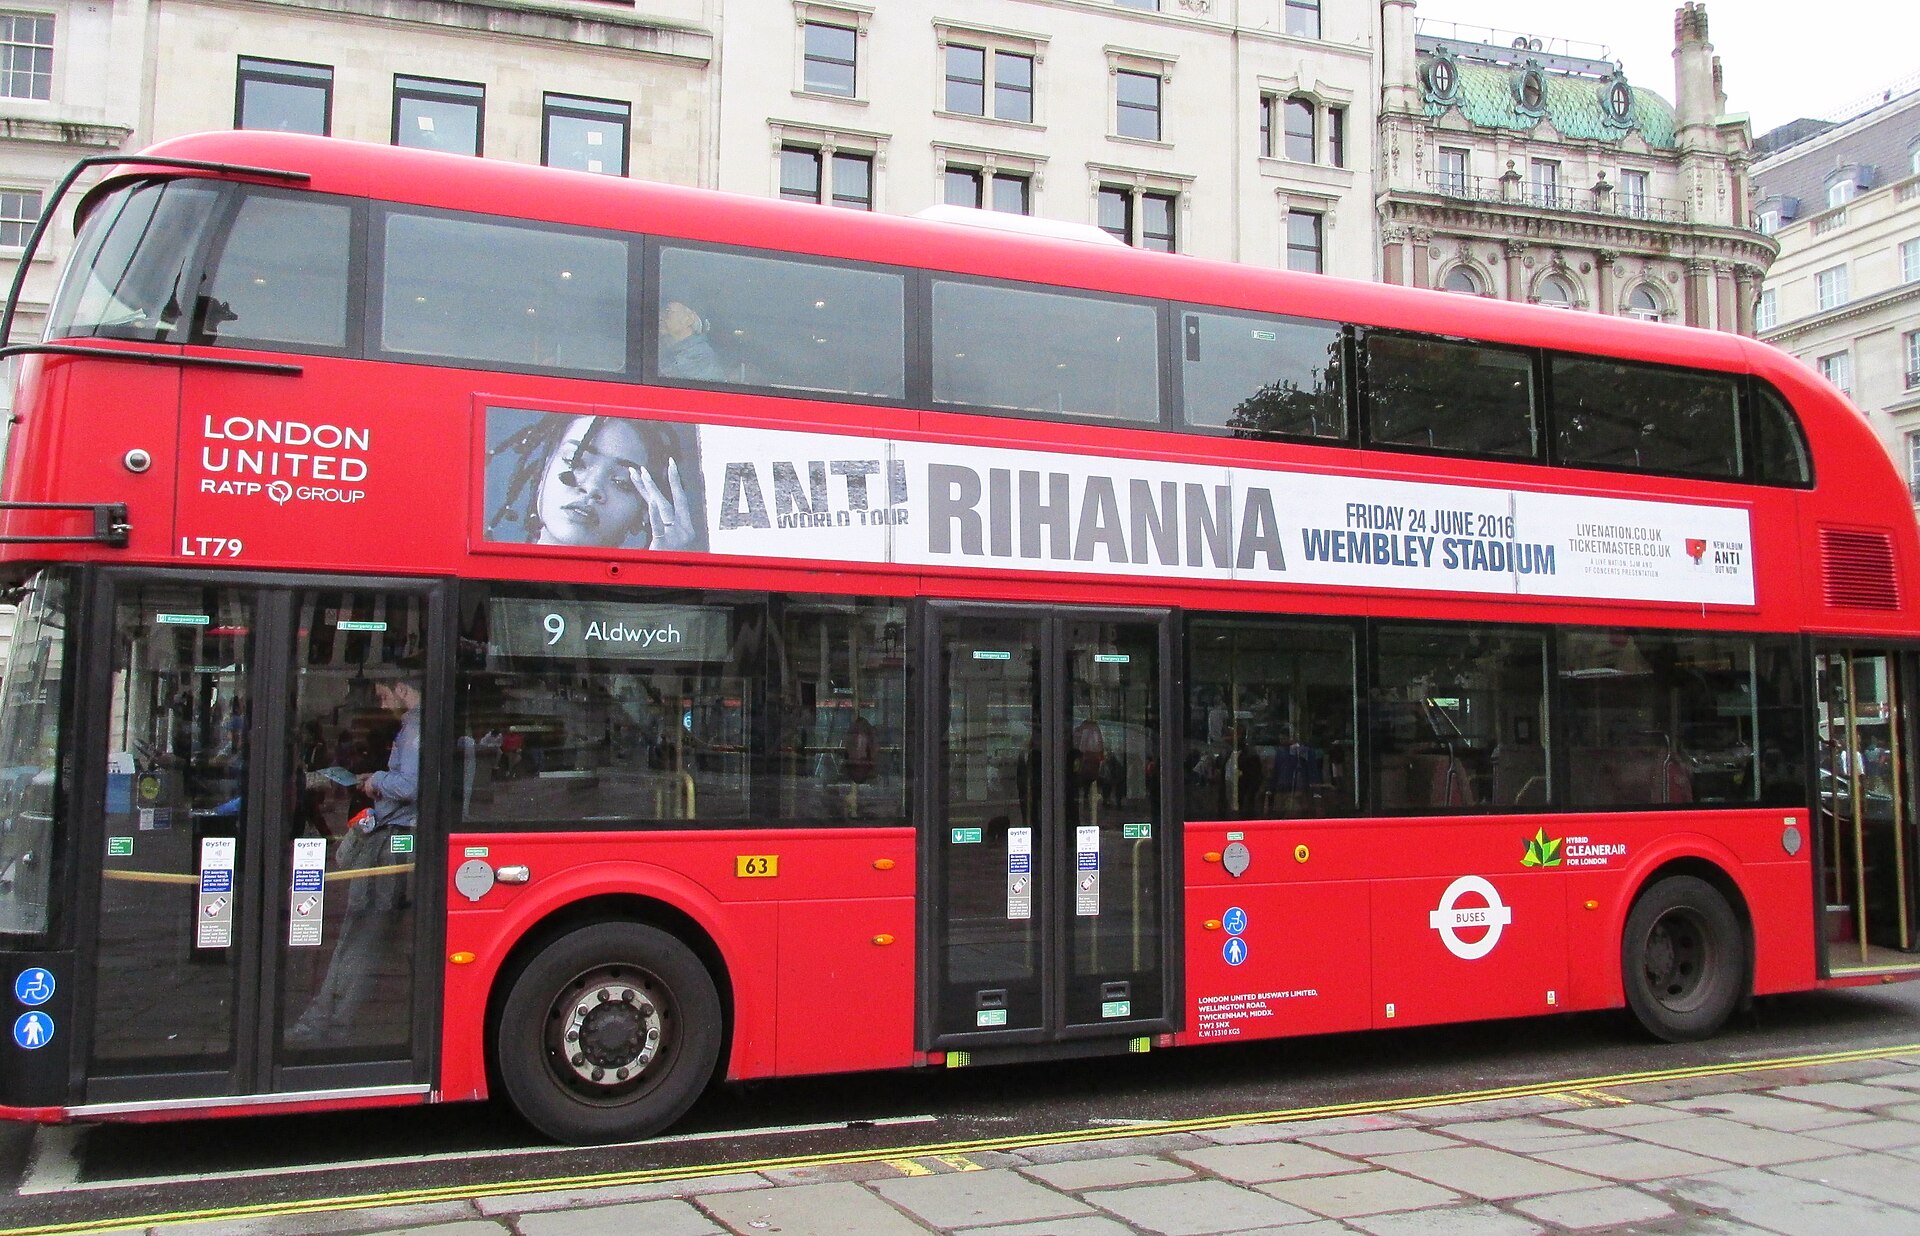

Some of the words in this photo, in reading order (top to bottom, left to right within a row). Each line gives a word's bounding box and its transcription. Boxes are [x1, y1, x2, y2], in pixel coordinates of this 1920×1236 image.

[204, 414, 369, 451] LONDON
[202, 446, 368, 482] UNITED
[200, 479, 262, 496] RATP
[296, 486, 366, 503] GROUP
[718, 459, 909, 531] ANTI
[776, 510, 850, 529] WORLD
[856, 507, 910, 527] TOUR
[928, 462, 1287, 572] RIHANNA
[1346, 502, 1404, 531] FRIDAY
[1408, 508, 1427, 533] 24
[1430, 509, 1474, 536] JUNE
[1477, 514, 1516, 539] 2016
[1576, 523, 1663, 541] LIVENATION.CO.UK
[181, 536, 243, 558] LT79
[1301, 527, 1435, 568] WEMBLEY
[1442, 537, 1557, 576] STADIUM
[1568, 538, 1671, 558] TICKETMASTER.CO.UK
[1713, 540, 1725, 549] NEW
[1726, 541, 1743, 551] ALBUM
[1714, 550, 1740, 565] ANTI
[1592, 566, 1620, 576] CONCERTS
[1621, 568, 1659, 578] PRESENTATION
[1714, 565, 1725, 574] OUT
[1725, 566, 1738, 574] NOW
[543, 613, 565, 645] 9
[584, 621, 681, 648] Aldwych
[205, 841, 231, 849] oyster
[297, 841, 321, 849] oyster
[1565, 836, 1589, 844] HYBRID
[1566, 844, 1626, 857] CLEANERAIR
[745, 857, 768, 875] 63
[1566, 858, 1580, 866] FOR
[1580, 857, 1608, 865] LONDON
[1456, 912, 1486, 923] BUSES
[1198, 996, 1230, 1004] LONDON
[1230, 994, 1256, 1002] UNITED
[1257, 991, 1289, 1000] BUSWAYS
[1290, 989, 1318, 998] LIMITED,
[1198, 1003, 1246, 1013] WELLINGTON
[1246, 1001, 1267, 1010] ROAD,
[1198, 1011, 1249, 1021] TWICKENHAM,
[1249, 1009, 1274, 1017] MIDDX.
[1198, 1022, 1215, 1030] TW2
[1228, 1028, 1241, 1036] KGS
